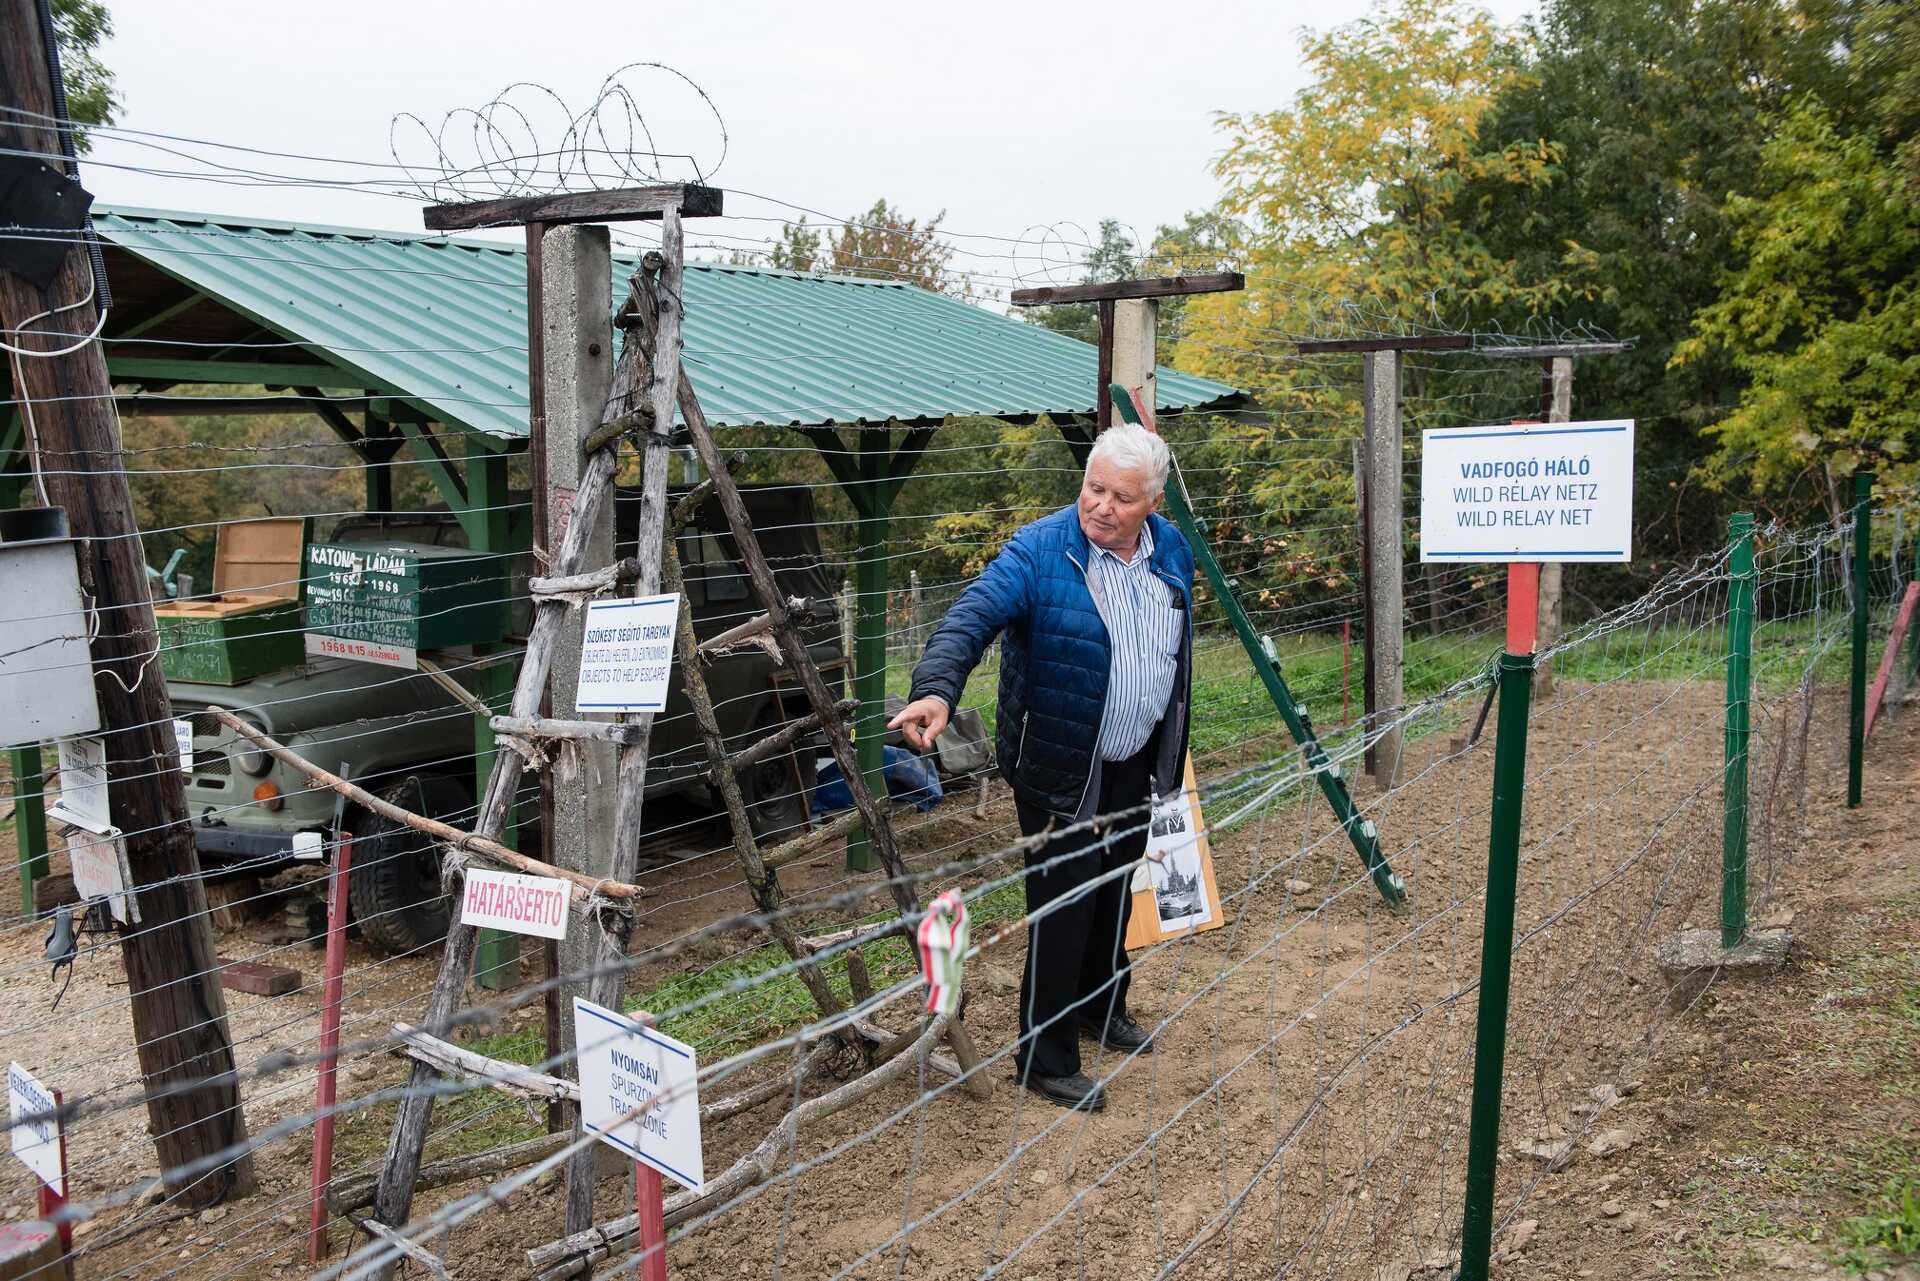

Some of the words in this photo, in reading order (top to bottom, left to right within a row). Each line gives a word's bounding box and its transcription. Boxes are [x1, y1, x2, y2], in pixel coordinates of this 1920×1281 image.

[1461, 457, 1539, 479] VADFOGÓ
[1545, 455, 1590, 476] HÁLÓ
[1453, 486, 1493, 503] WILD
[1499, 485, 1551, 502] RELAY
[1556, 483, 1598, 501] NETZ
[1457, 511, 1497, 527] WILD
[1503, 509, 1555, 526] RELAY
[1561, 508, 1593, 526] NET
[371, 579, 399, 593] 1968
[321, 641, 346, 653] 1968
[610, 1048, 659, 1086] NYOMSÁV
